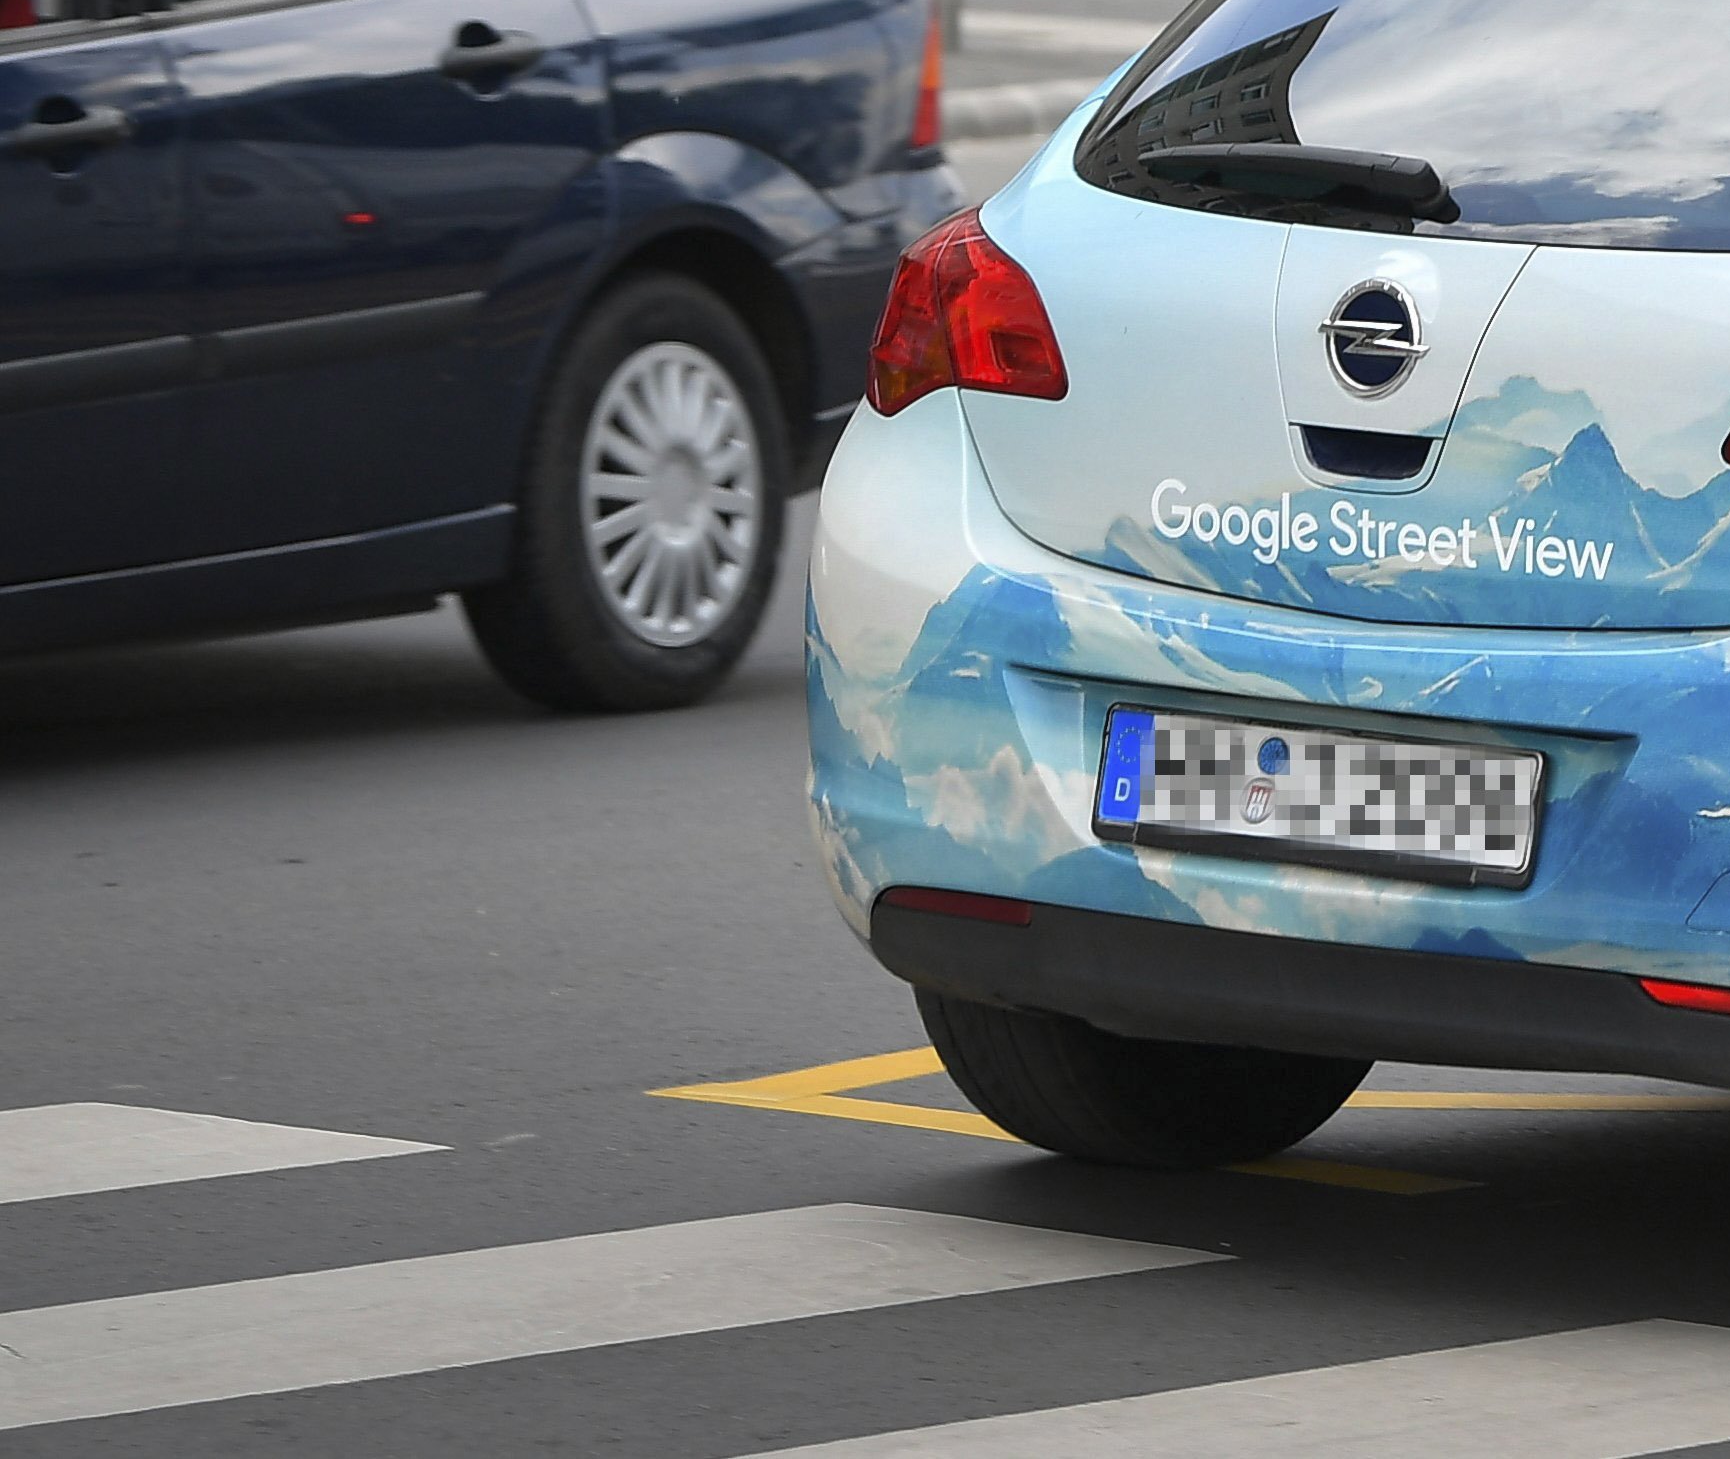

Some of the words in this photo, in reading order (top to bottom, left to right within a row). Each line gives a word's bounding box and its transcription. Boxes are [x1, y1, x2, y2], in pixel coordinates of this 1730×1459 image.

[1150, 478, 1319, 564] Google
[1329, 500, 1477, 569] Street
[1488, 515, 1615, 580] View
[1114, 777, 1131, 802] D
